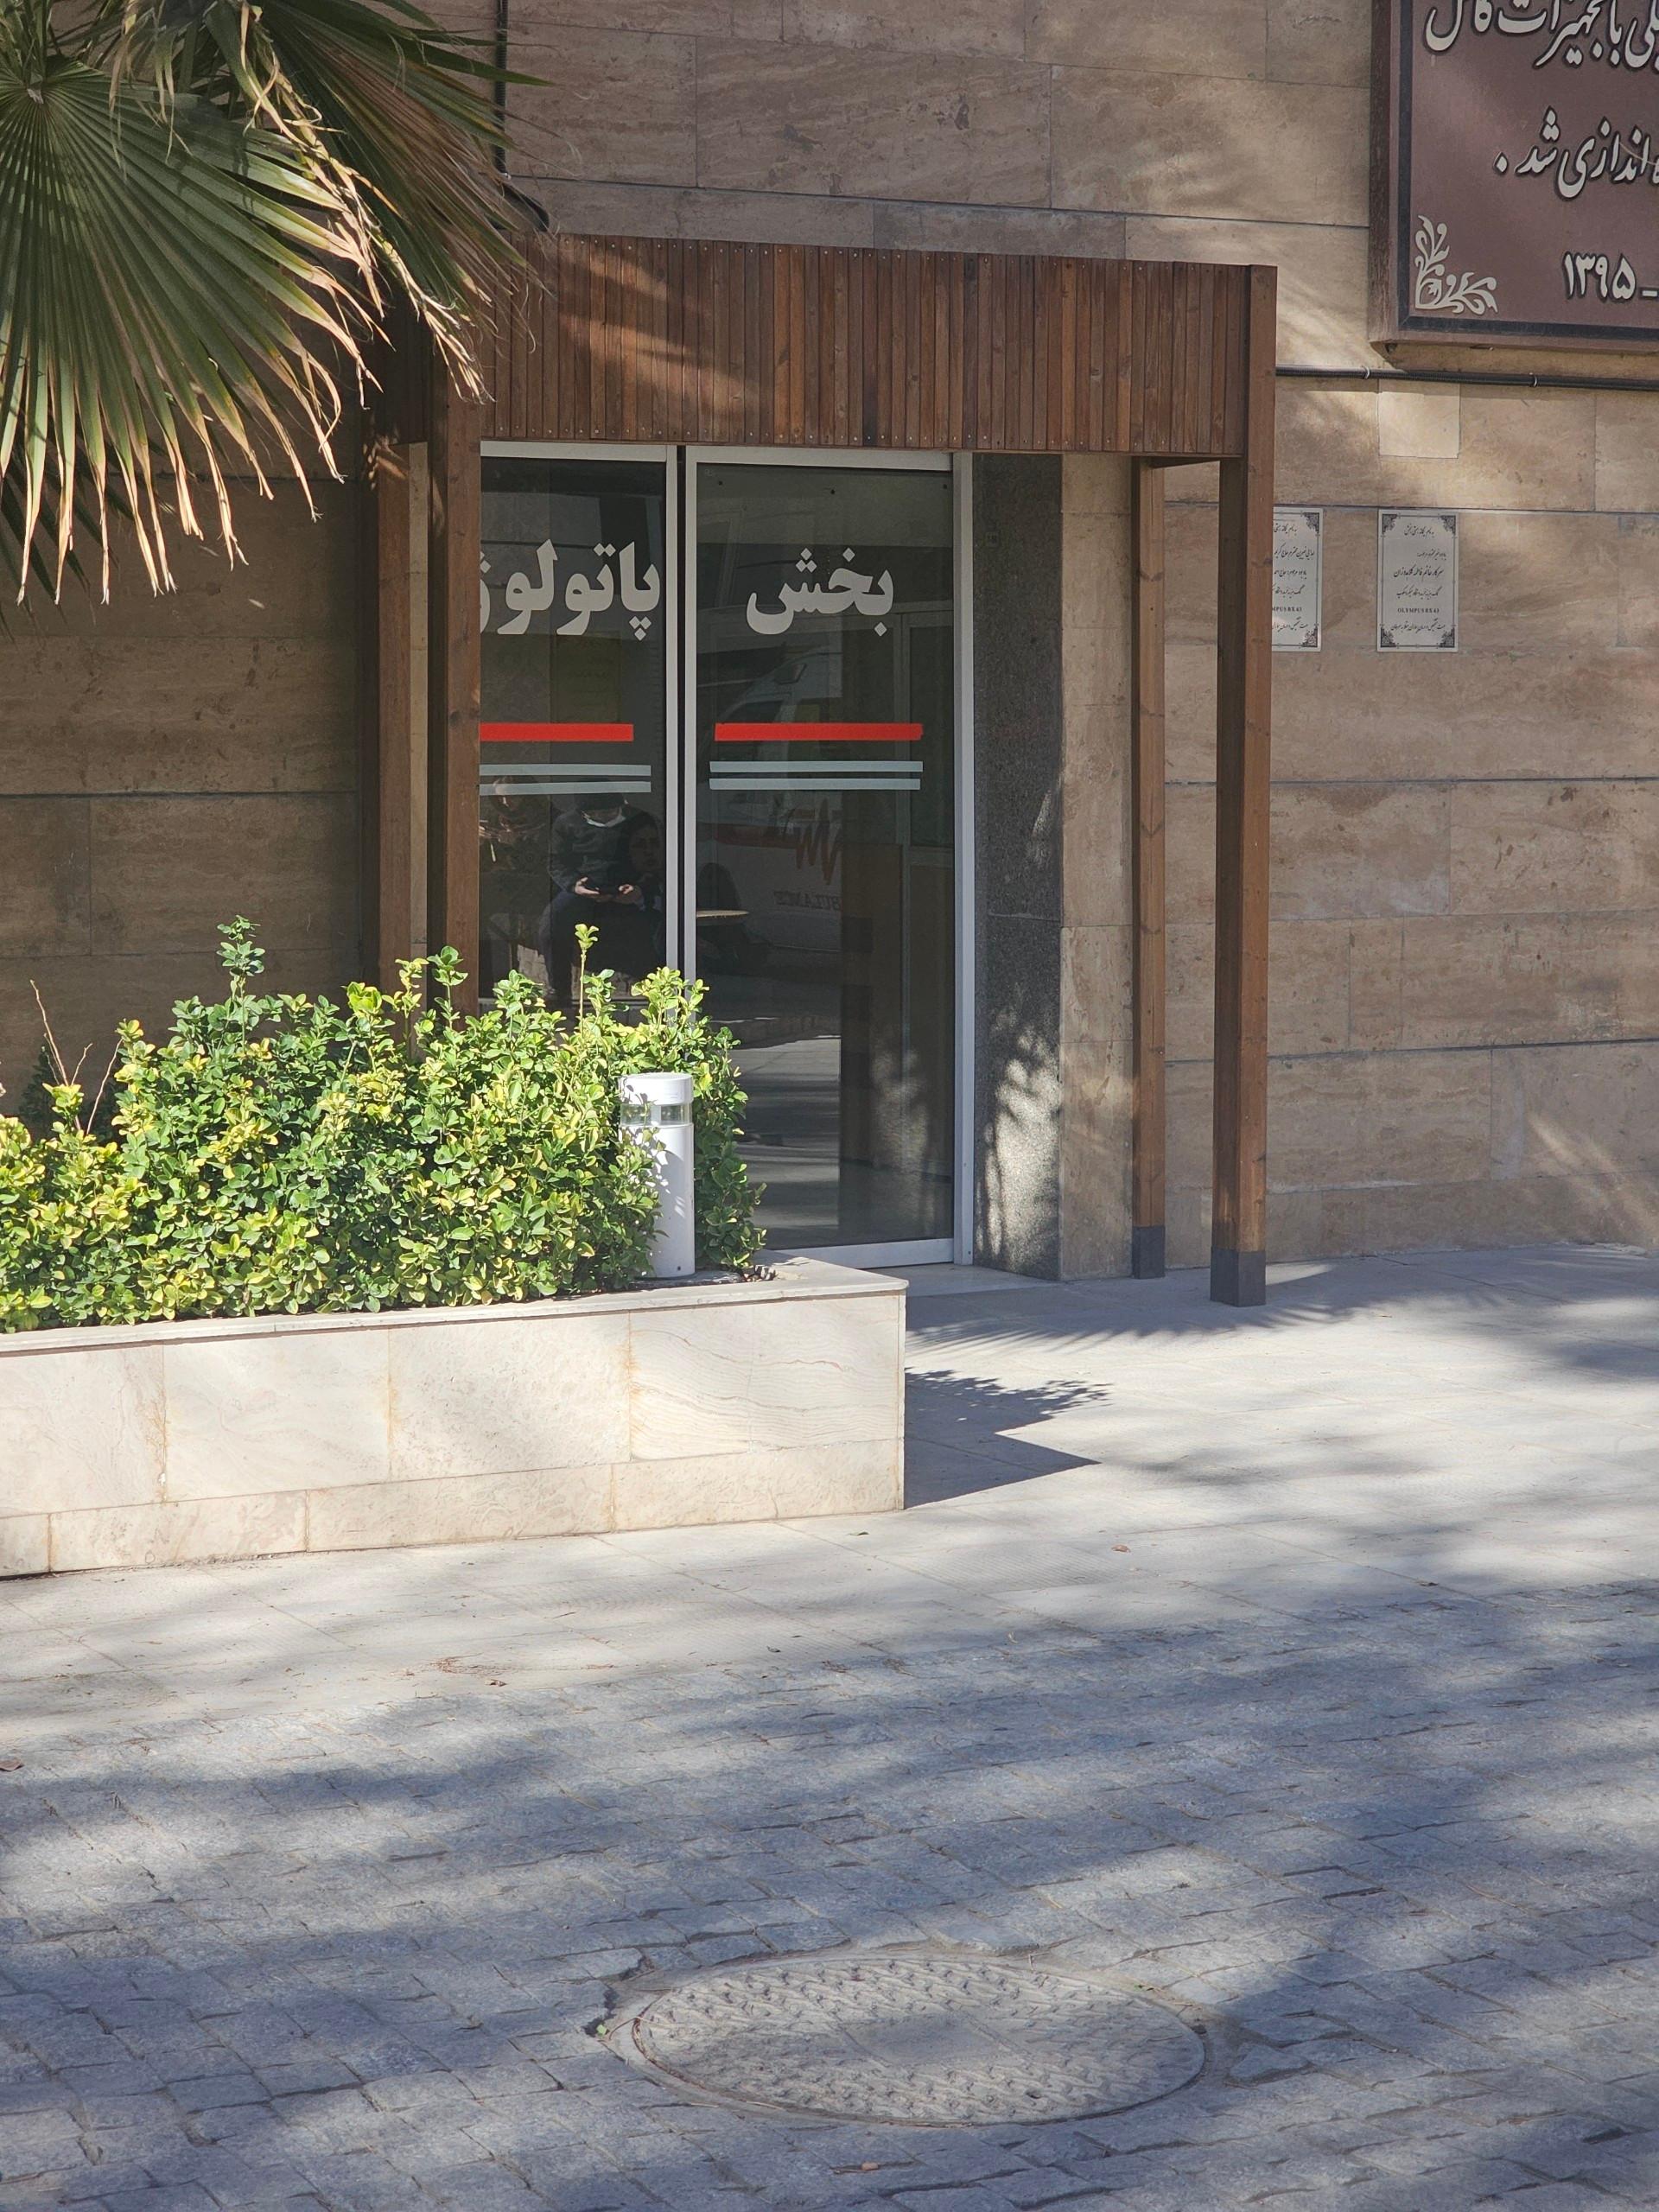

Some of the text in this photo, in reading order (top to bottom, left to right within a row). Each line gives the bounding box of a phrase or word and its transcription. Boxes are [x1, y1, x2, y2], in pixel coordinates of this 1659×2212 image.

[1564, 254, 1636, 300] ۱۳۹۵
[480, 538, 893, 641] بخش پاتولو
